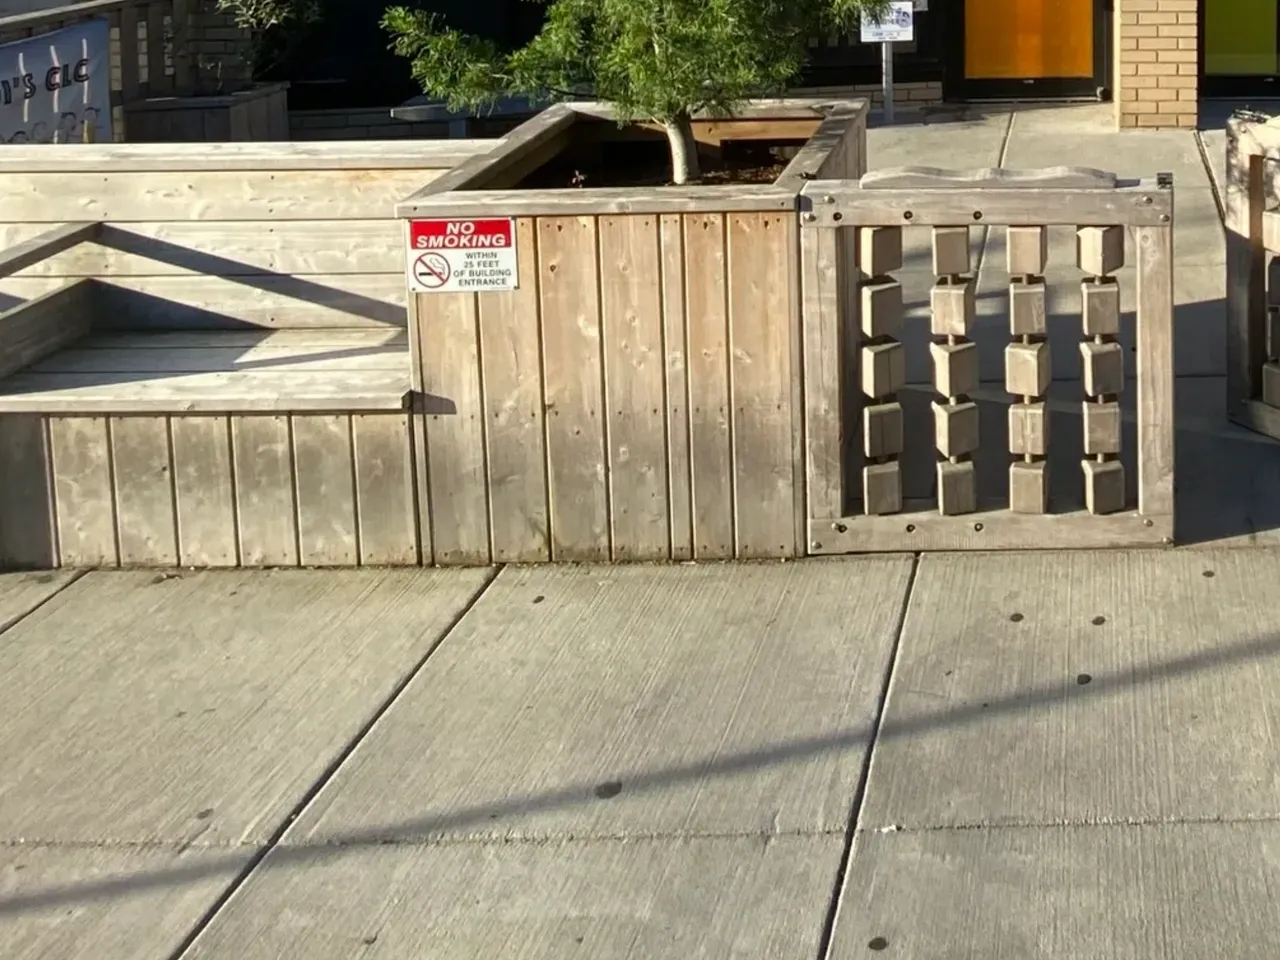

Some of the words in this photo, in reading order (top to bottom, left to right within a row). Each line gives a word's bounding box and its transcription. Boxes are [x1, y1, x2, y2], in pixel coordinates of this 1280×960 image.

[0, 72, 37, 105] I'S
[45, 58, 90, 92] CLC
[446, 221, 475, 235] NO
[416, 234, 506, 248] SMOKING
[465, 251, 498, 260] WITHIN
[463, 261, 474, 269] 25
[477, 260, 500, 268] FEET
[468, 268, 512, 277] BUILDING
[458, 278, 507, 287] ENTRANCE
